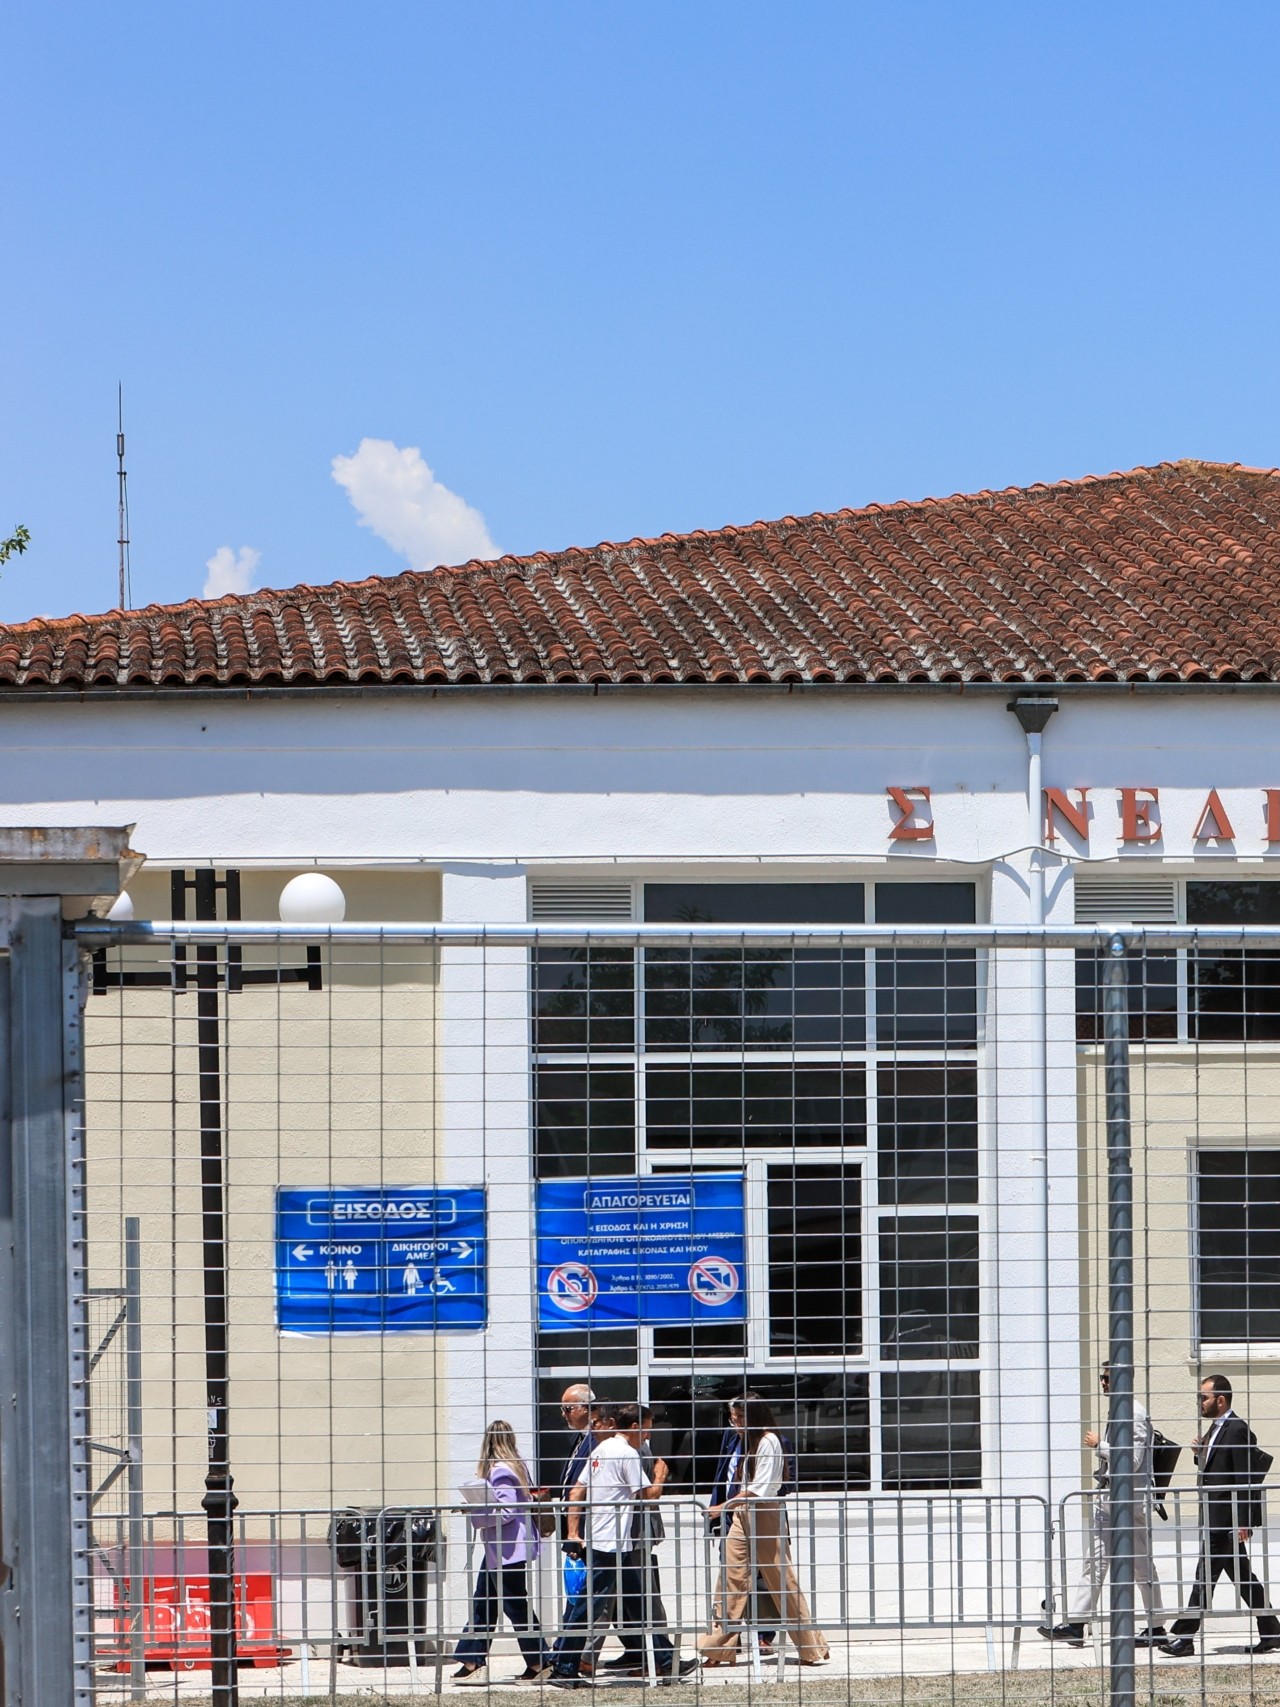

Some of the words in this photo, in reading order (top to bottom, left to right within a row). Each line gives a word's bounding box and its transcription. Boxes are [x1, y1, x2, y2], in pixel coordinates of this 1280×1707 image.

[591, 1193, 690, 1208] ΑΠΑΓΟΡΕΥΕΤΑΙ
[333, 1202, 431, 1220] ΕΙΣΟΔΟΣ
[595, 1223, 630, 1232] ΕΙΣΟΔΟΣ
[633, 1222, 648, 1231] ΚΑΙ
[651, 1222, 657, 1230] Η
[659, 1221, 688, 1230] ΧΡΗΣΗ
[320, 1245, 362, 1255] ΚΟΙΝΟ
[392, 1242, 449, 1252] ΔΙΚΗΓΟΡΟΙ
[577, 1247, 631, 1257] ΚΑΤΑΓΡΑΦΗΣ
[632, 1246, 668, 1256] ΕΚΟΝΑΣ
[669, 1245, 684, 1254] ΚΑΙ
[685, 1244, 709, 1253] ΗΧΟΥ
[405, 1251, 435, 1260] ΑΜΕΑ
